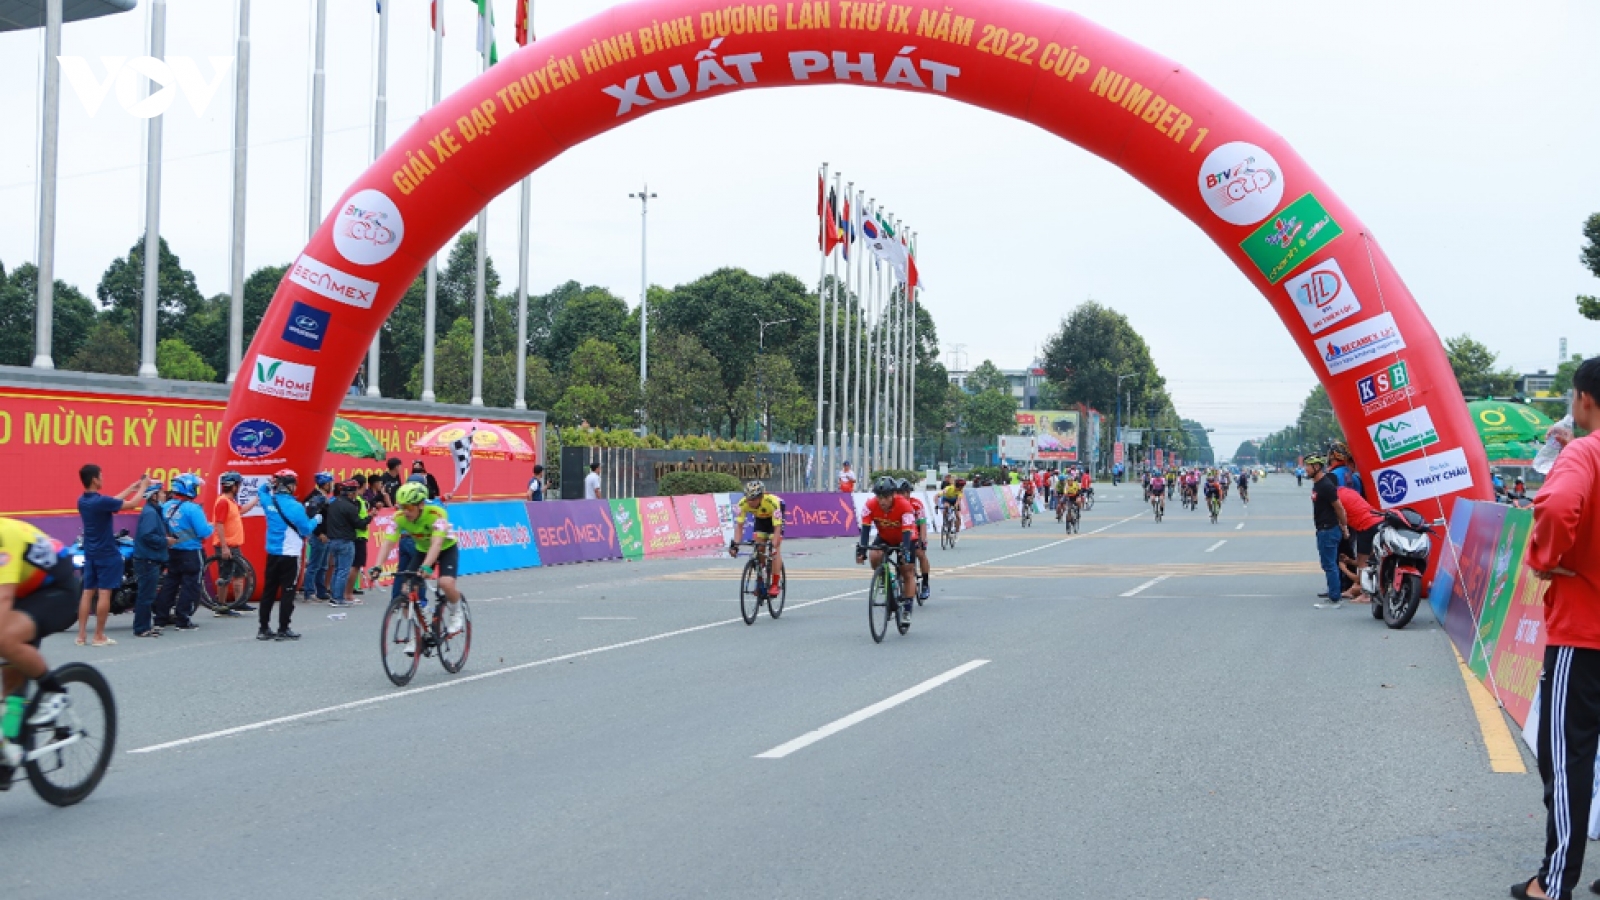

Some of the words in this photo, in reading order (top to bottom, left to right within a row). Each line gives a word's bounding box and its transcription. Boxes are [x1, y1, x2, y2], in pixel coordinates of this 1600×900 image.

[600, 37, 764, 118] XUẤT
[788, 45, 962, 93] PHÁT
[391, 150, 437, 196] GIẢI
[428, 127, 463, 163] XE
[456, 99, 498, 143] ĐẠP
[496, 58, 582, 114] TRUYỀN
[580, 32, 638, 75] HÌNH
[638, 15, 696, 56] BÌNH
[700, 6, 779, 39] DƯƠNG
[885, 4, 910, 34] IX
[916, 7, 976, 47] NĂM
[976, 24, 1040, 65] 2022
[1038, 41, 1091, 83] CÚP
[1089, 65, 1195, 144] NUMBER
[1187, 126, 1210, 154] 1
[274, 375, 311, 392] HOME
[1360, 365, 1407, 400] KSB
[24, 405, 114, 446] MỪNG
[124, 408, 159, 448] KỶ
[165, 413, 224, 455] NIỆM
[538, 517, 606, 548] BECAMEX
